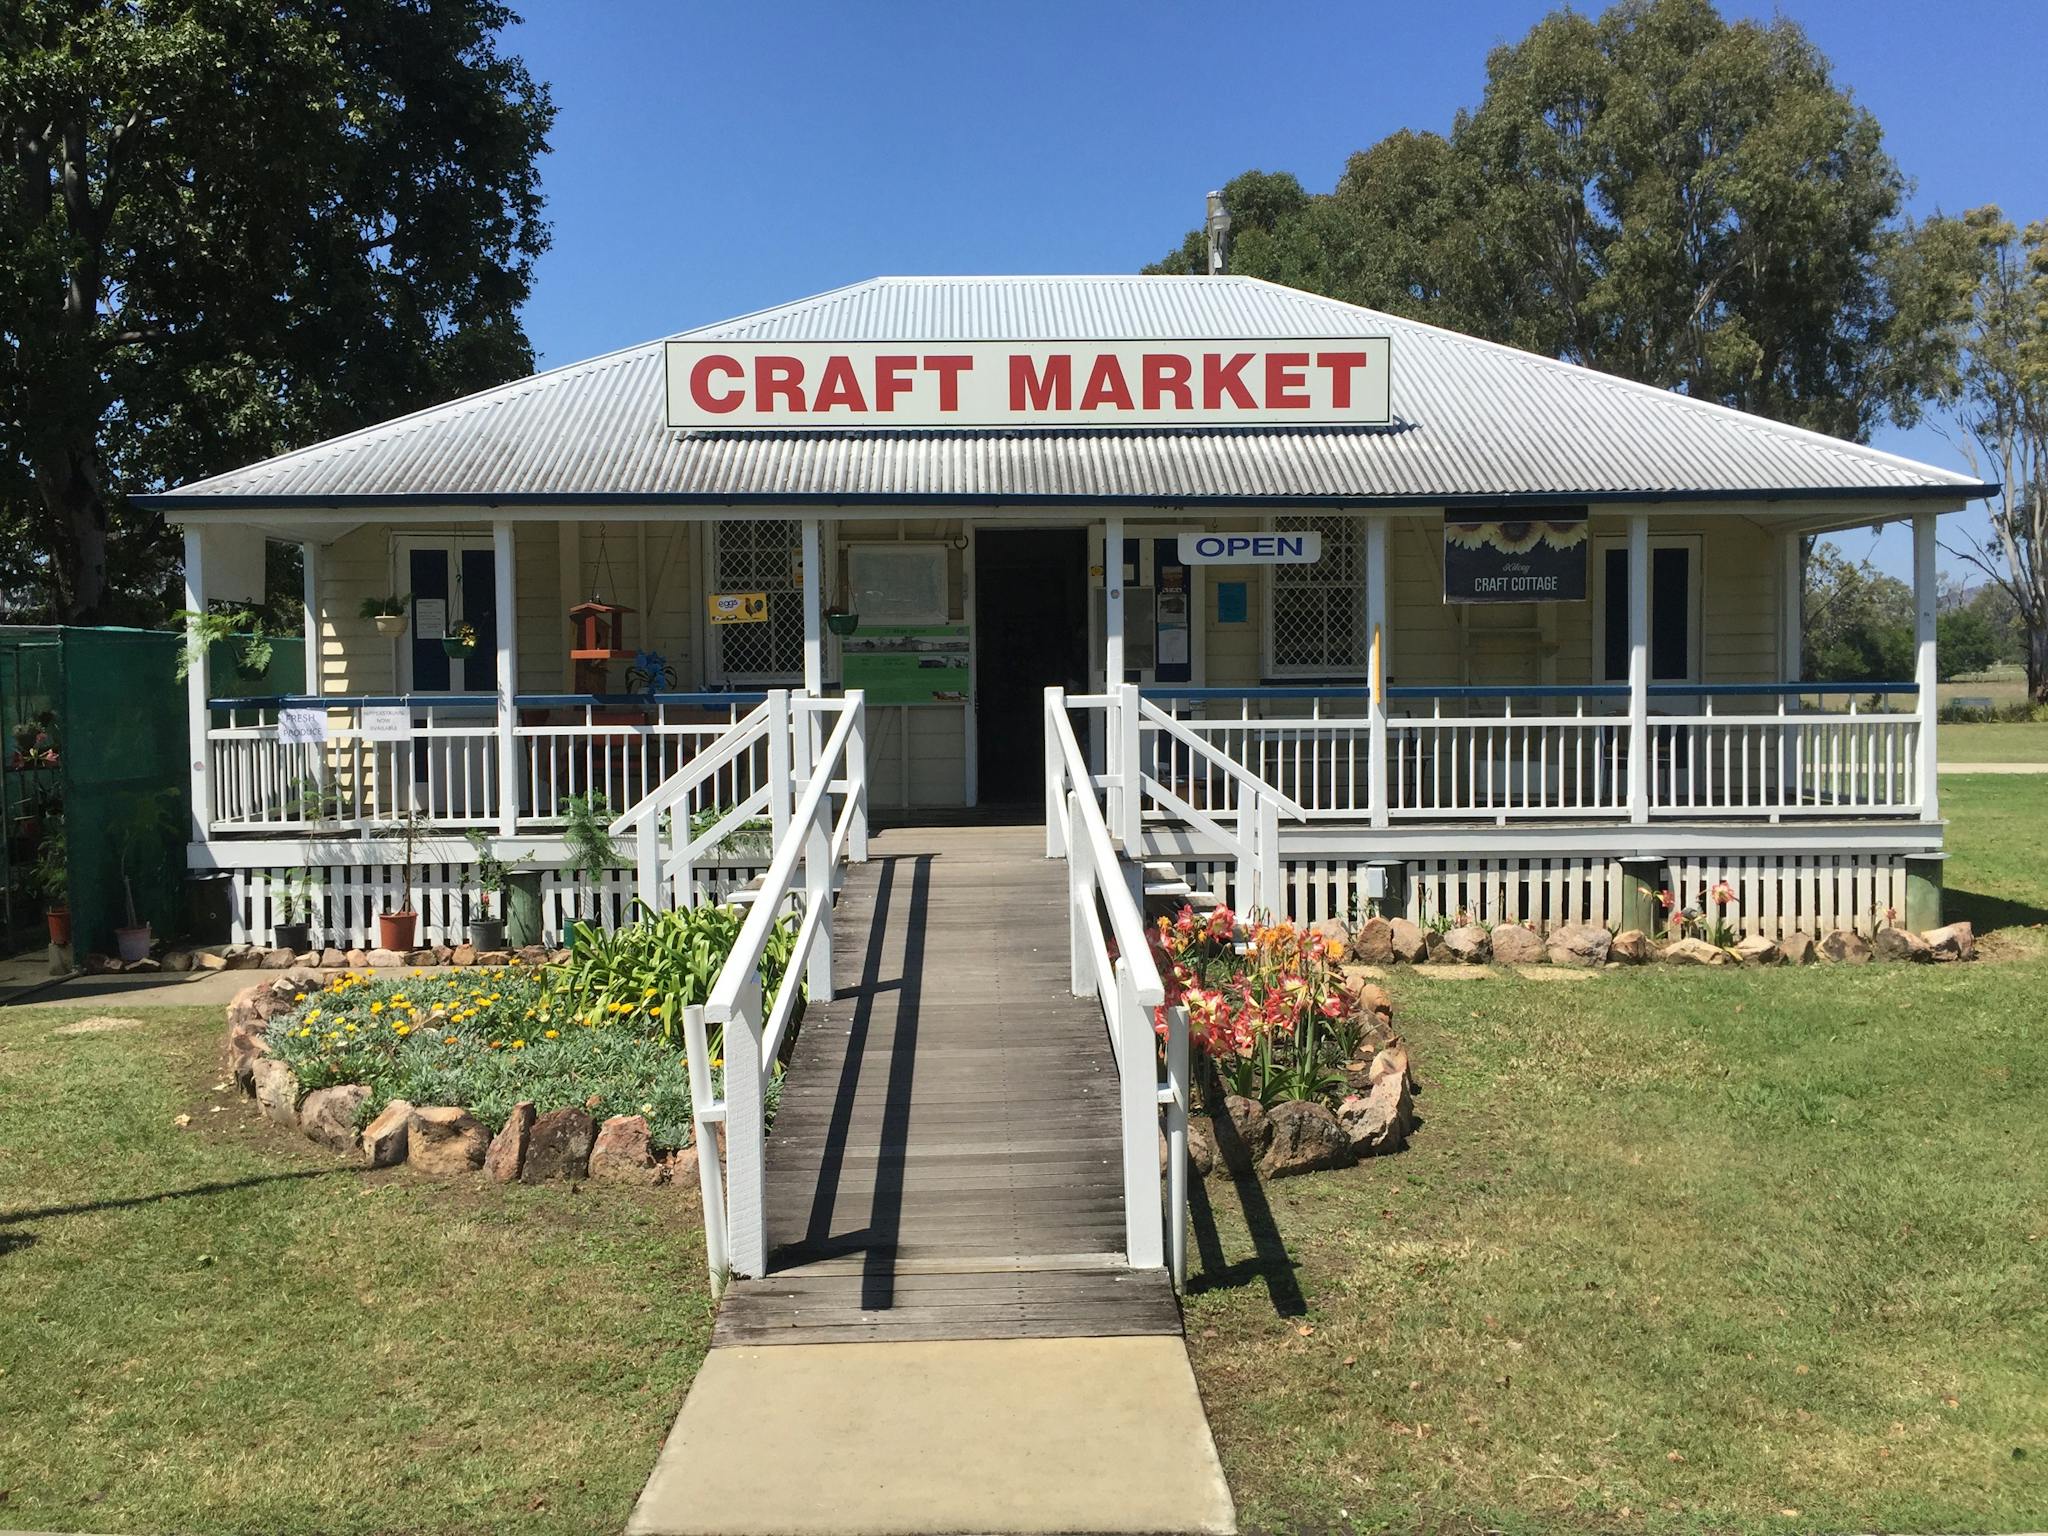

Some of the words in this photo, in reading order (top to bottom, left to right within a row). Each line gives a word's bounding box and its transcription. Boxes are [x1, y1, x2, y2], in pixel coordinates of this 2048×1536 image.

[689, 354, 973, 414] CRAFT
[1008, 352, 1367, 411] MARKET
[1195, 537, 1303, 557] OPEN
[1474, 577, 1508, 591] CRAFT
[1511, 576, 1558, 591] COTTAGE
[719, 599, 738, 609] eggs
[286, 714, 316, 722] FRESH
[283, 728, 322, 737] PRODUCE
